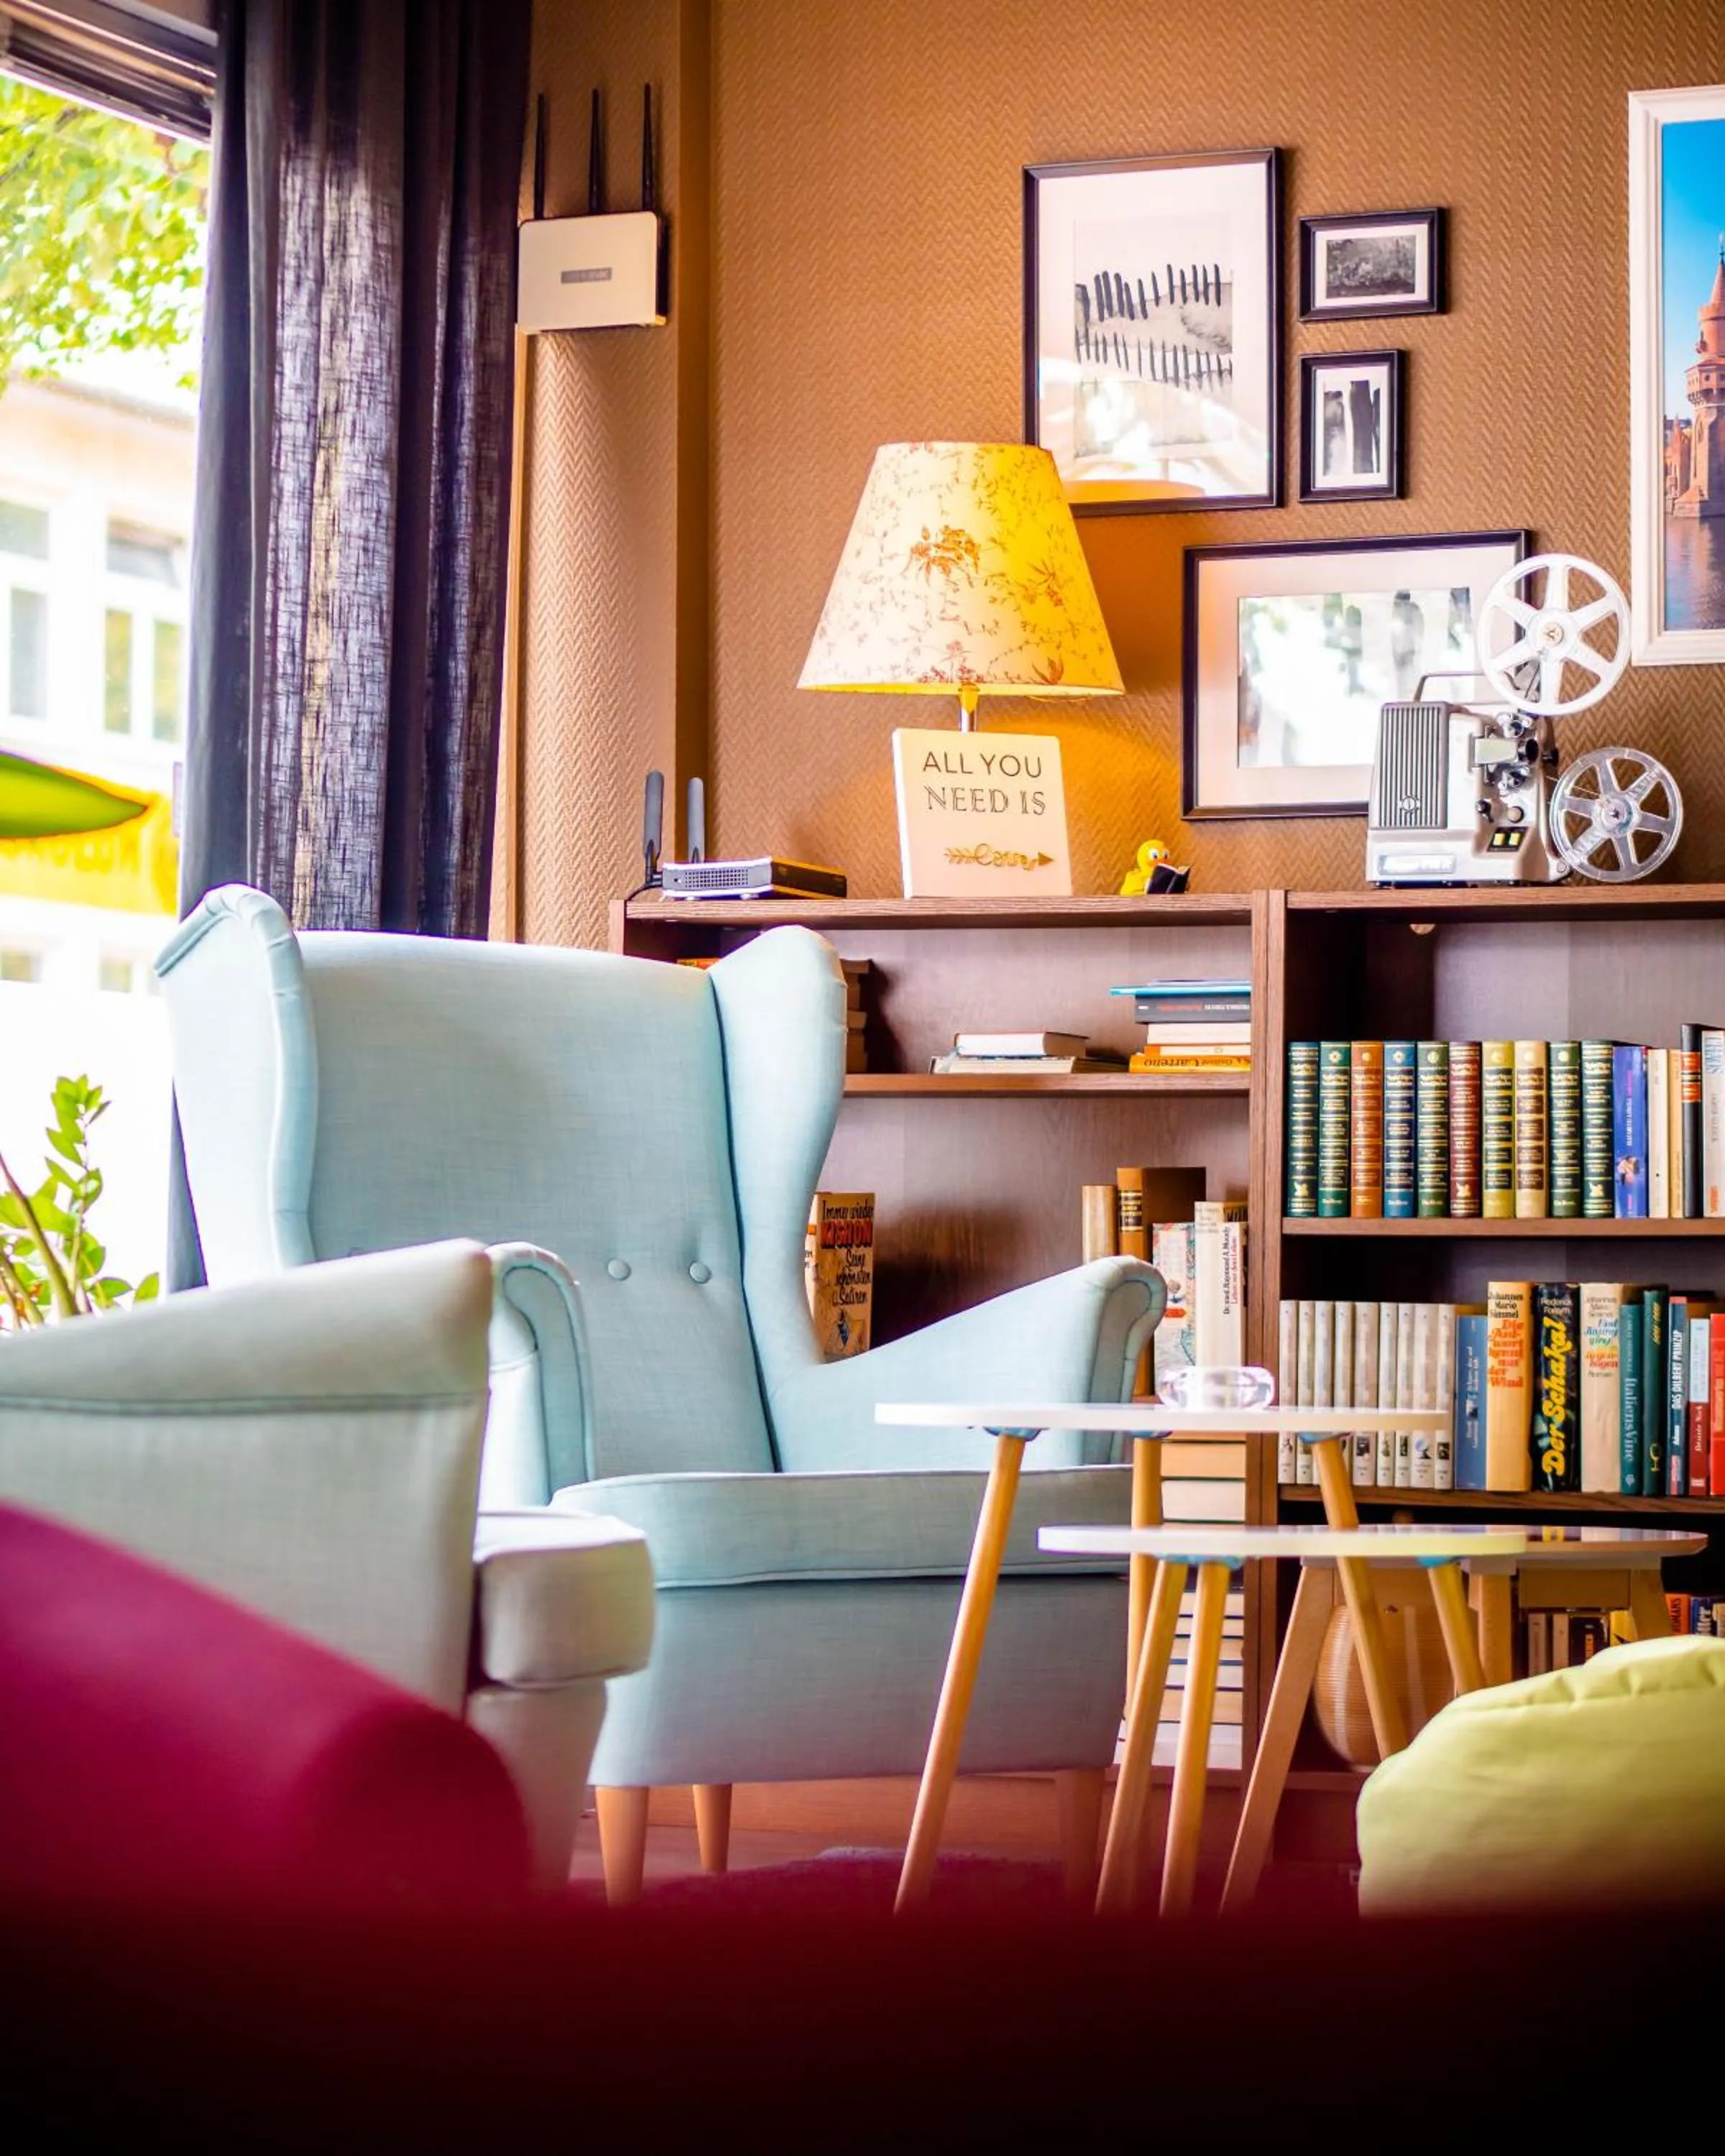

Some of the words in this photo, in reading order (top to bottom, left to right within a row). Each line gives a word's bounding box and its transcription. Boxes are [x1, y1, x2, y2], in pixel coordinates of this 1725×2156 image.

[922, 750, 973, 774] ALL
[980, 752, 1042, 778] YOU
[923, 785, 1009, 813] NEED
[1019, 789, 1046, 816] IS
[1672, 1330, 1683, 1360] PRINZIP
[1542, 1316, 1573, 1424] Schakal
[1671, 1362, 1683, 1393] DILBERT
[1672, 1393, 1682, 1409] DAS
[1542, 1423, 1565, 1476] Der
